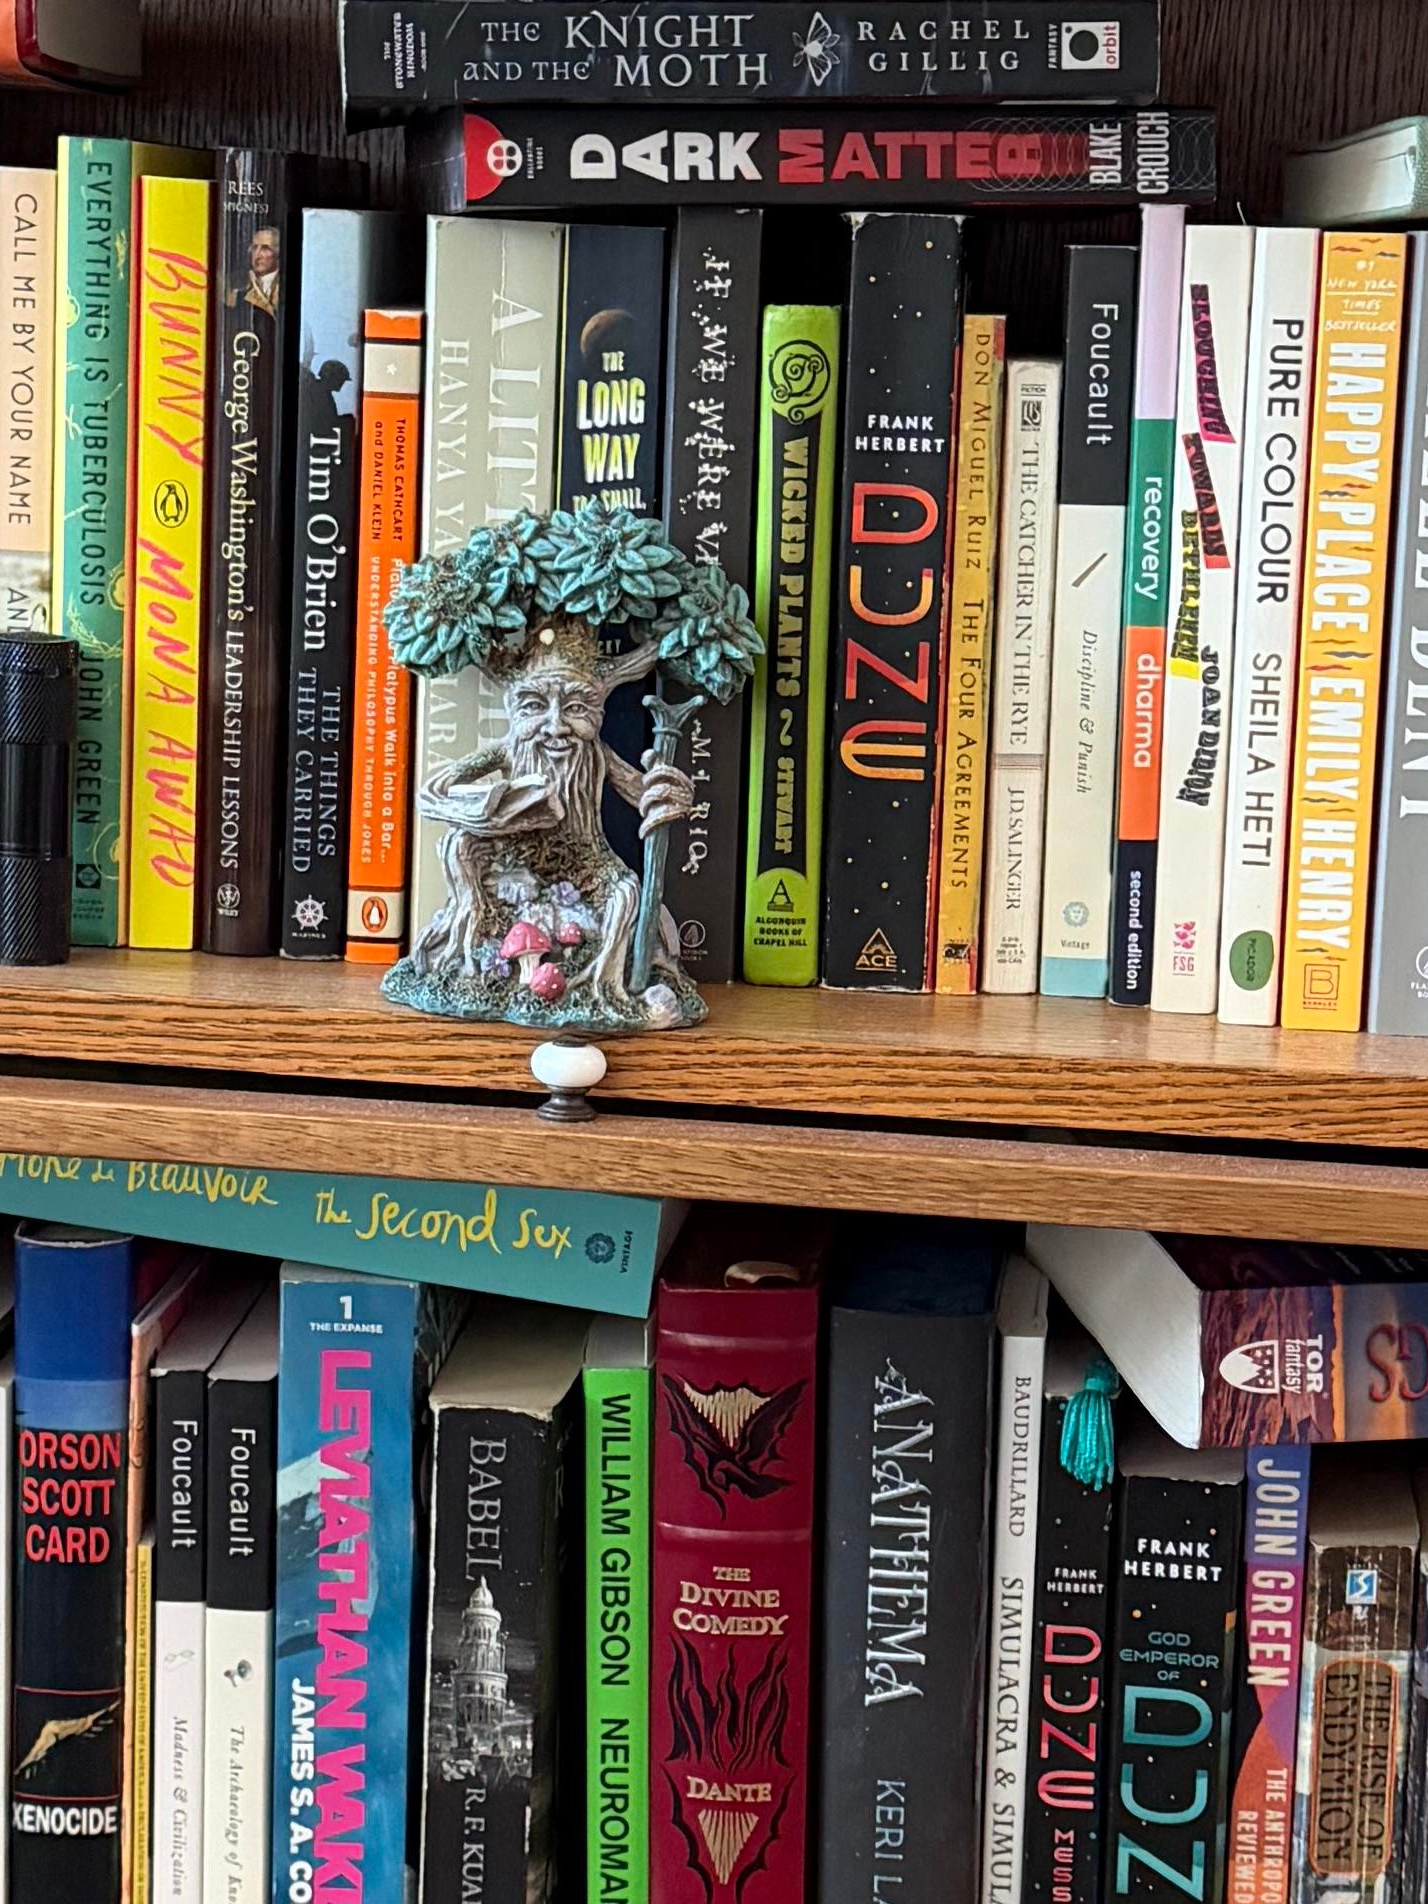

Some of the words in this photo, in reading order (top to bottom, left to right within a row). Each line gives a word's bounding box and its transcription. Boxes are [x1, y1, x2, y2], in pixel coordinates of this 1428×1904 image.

[482, 22, 539, 42] THE
[564, 15, 755, 48] KNIGHT
[533, 61, 589, 80] THE
[614, 54, 768, 87] MOTH
[1105, 24, 1118, 65] orbit
[572, 133, 762, 181] DARK
[779, 129, 1042, 181] MATTER
[1086, 302, 1118, 446] Foucault
[1321, 343, 1386, 485] HAPPY
[1134, 476, 1162, 601] recovery
[1311, 494, 1374, 637] PLACE
[840, 483, 939, 780] DUNE
[1134, 652, 1155, 768] dharma
[1307, 678, 1365, 803] EMILY
[1296, 810, 1358, 951] HENRY
[171, 1419, 198, 1550] Foucault
[229, 1427, 256, 1558] Foucault
[600, 1392, 631, 1535] WILLIAM
[315, 1349, 372, 1730] LEVIATHAN
[680, 1582, 780, 1609] DIVINE
[713, 1566, 749, 1582] THE
[600, 1547, 630, 1687] GIBSON
[673, 1609, 787, 1635] COMEDY
[1120, 1649, 1219, 1669] EMPEROR
[1149, 1631, 1190, 1646] GOD
[1157, 1669, 1179, 1680] OF
[12, 1802, 117, 1836] XENOCIDE
[687, 1778, 772, 1802] DANTE
